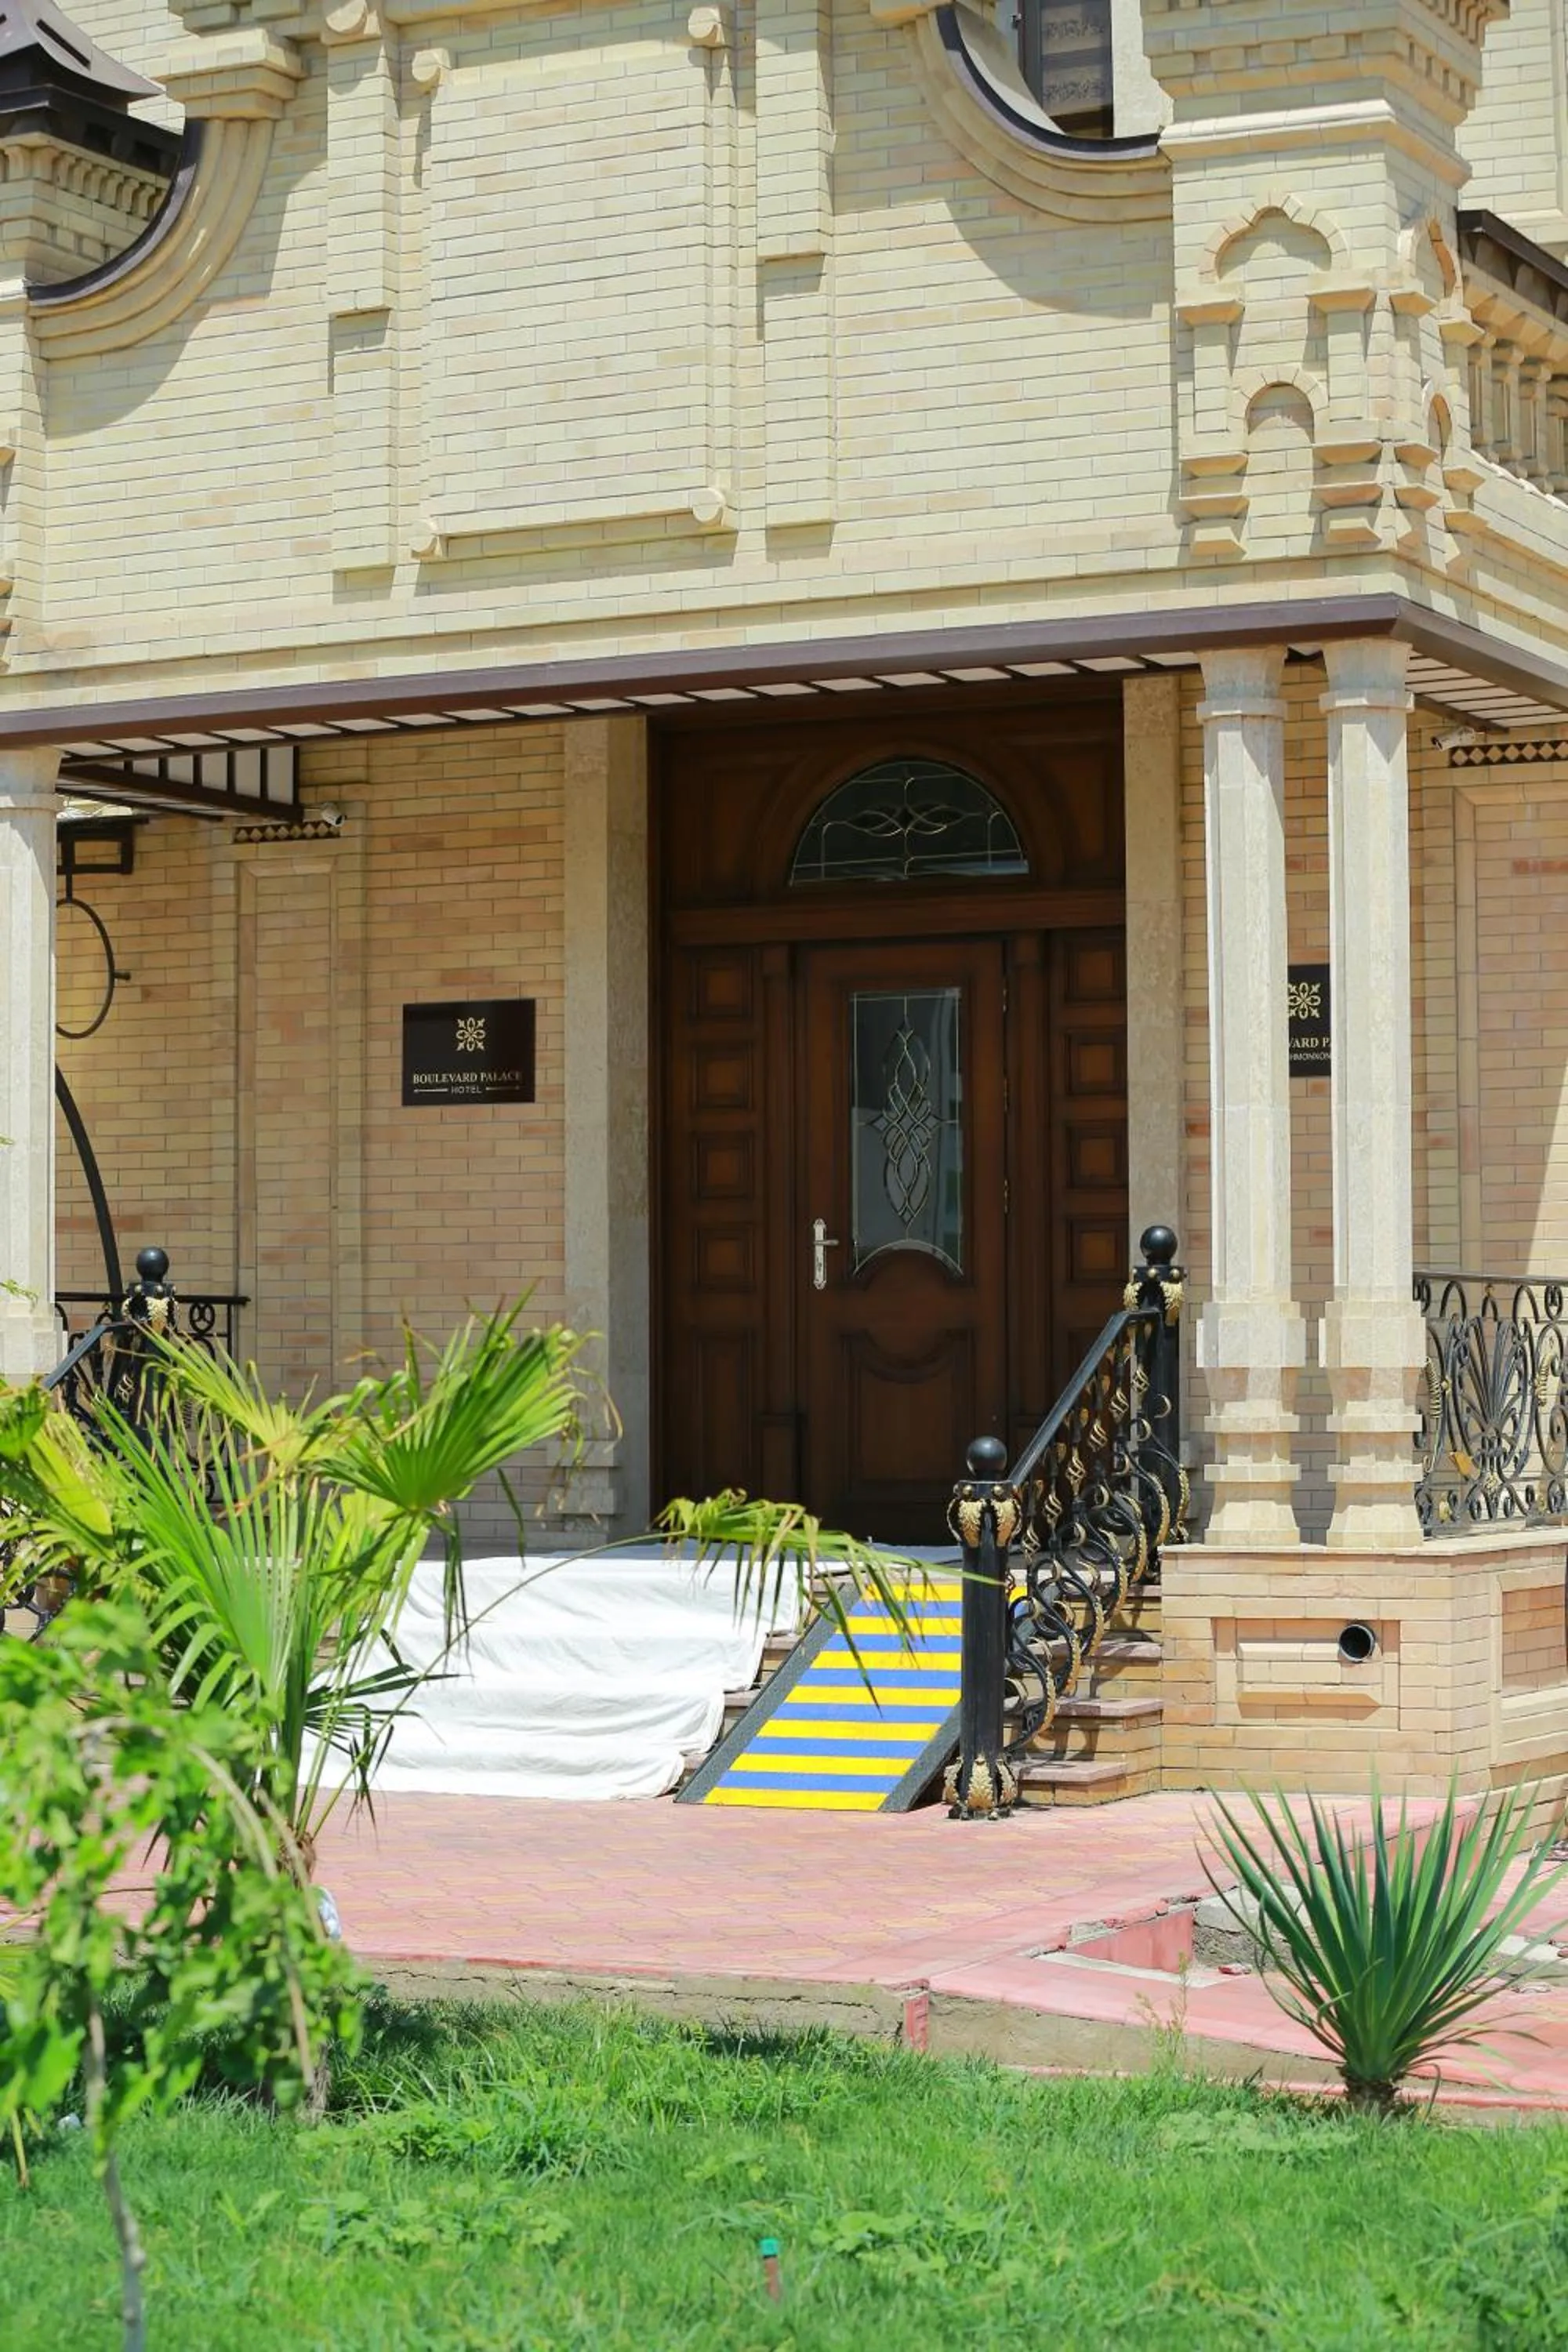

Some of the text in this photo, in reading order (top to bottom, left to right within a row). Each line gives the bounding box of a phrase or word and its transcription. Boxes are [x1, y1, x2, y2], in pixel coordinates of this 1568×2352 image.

[1323, 1036, 1330, 1047] P
[413, 1071, 521, 1084] BOULEVARD PALACE
[451, 1085, 482, 1094] HOTEL
